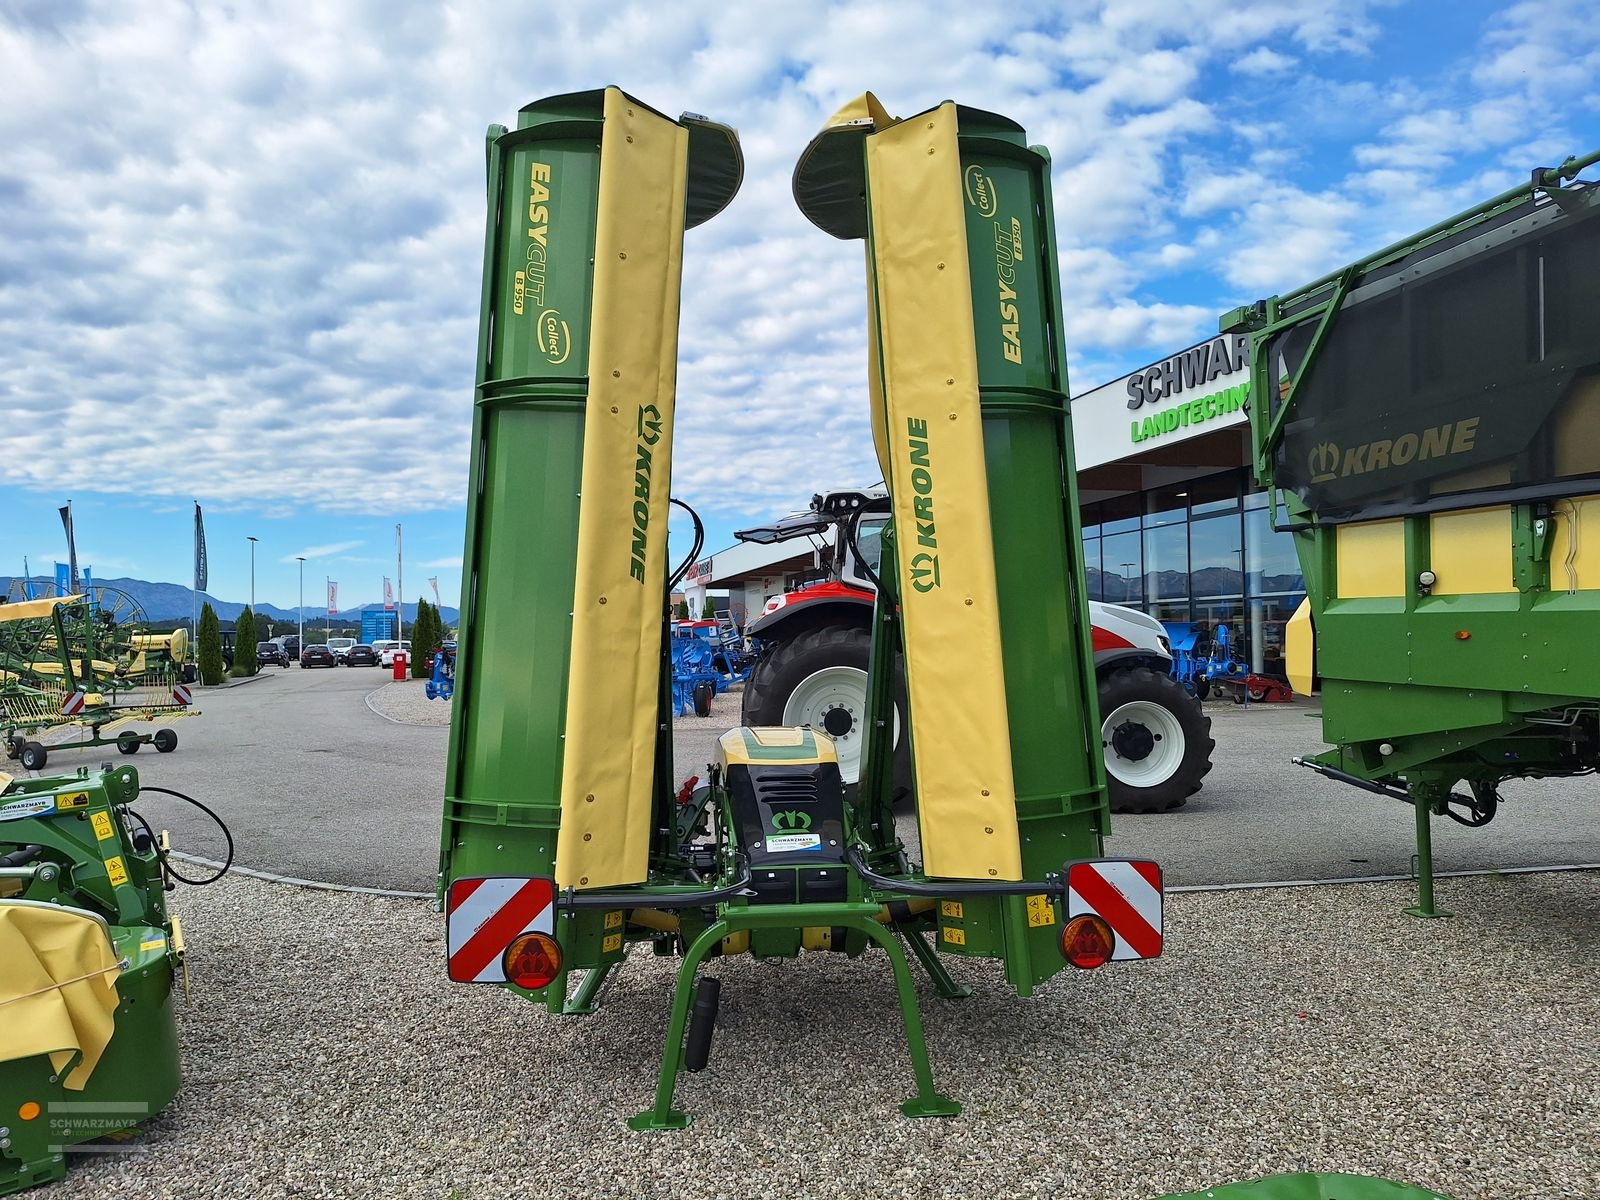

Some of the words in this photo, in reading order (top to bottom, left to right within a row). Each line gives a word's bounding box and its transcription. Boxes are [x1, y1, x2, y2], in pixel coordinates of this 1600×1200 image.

[974, 172, 989, 210] Collect
[525, 162, 551, 306] EASYCUT
[1013, 224, 1022, 246] 950
[514, 288, 523, 309] 950
[515, 277, 524, 285] B
[994, 221, 1022, 365] EASYCUT
[547, 317, 560, 356] Collect
[1131, 380, 1250, 444] LANDTECHN
[1341, 416, 1480, 478] KRONE
[907, 416, 938, 549] KRONE
[630, 443, 652, 585] KRONE
